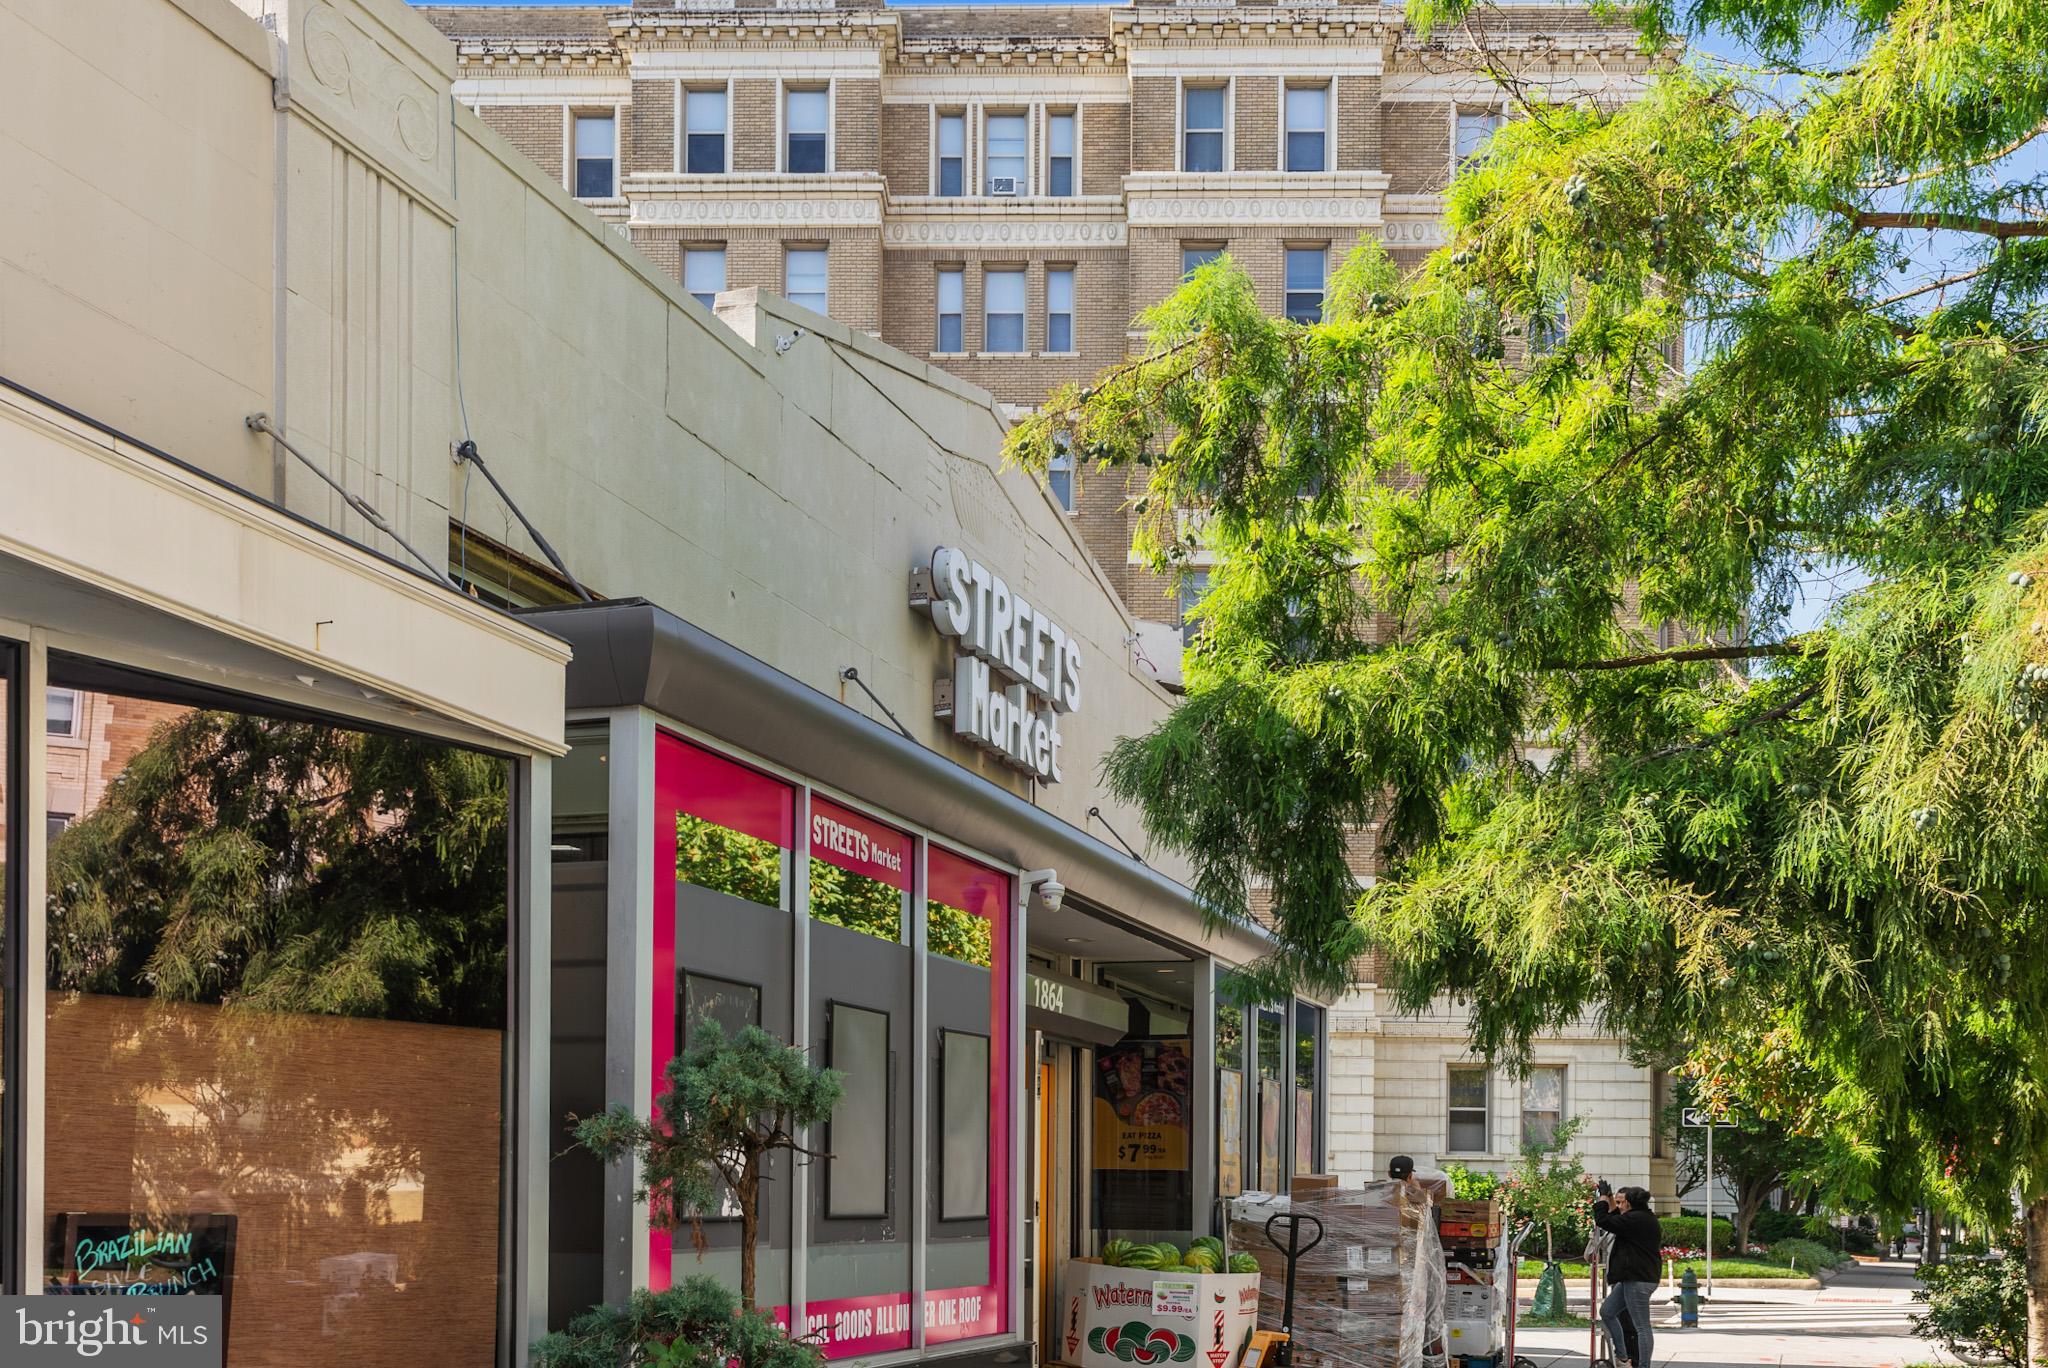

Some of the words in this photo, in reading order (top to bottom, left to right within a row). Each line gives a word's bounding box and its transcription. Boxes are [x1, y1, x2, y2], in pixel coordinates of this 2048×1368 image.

[931, 546, 1082, 714] STREETS
[955, 656, 1062, 784] Market
[813, 814, 870, 863] STREETS
[871, 841, 902, 873] Market
[1034, 978, 1064, 1014] 1864
[834, 1307, 873, 1342] GOODS
[875, 1305, 895, 1336] ALL
[938, 1298, 957, 1327] ONE
[958, 1295, 982, 1324] ROOF
